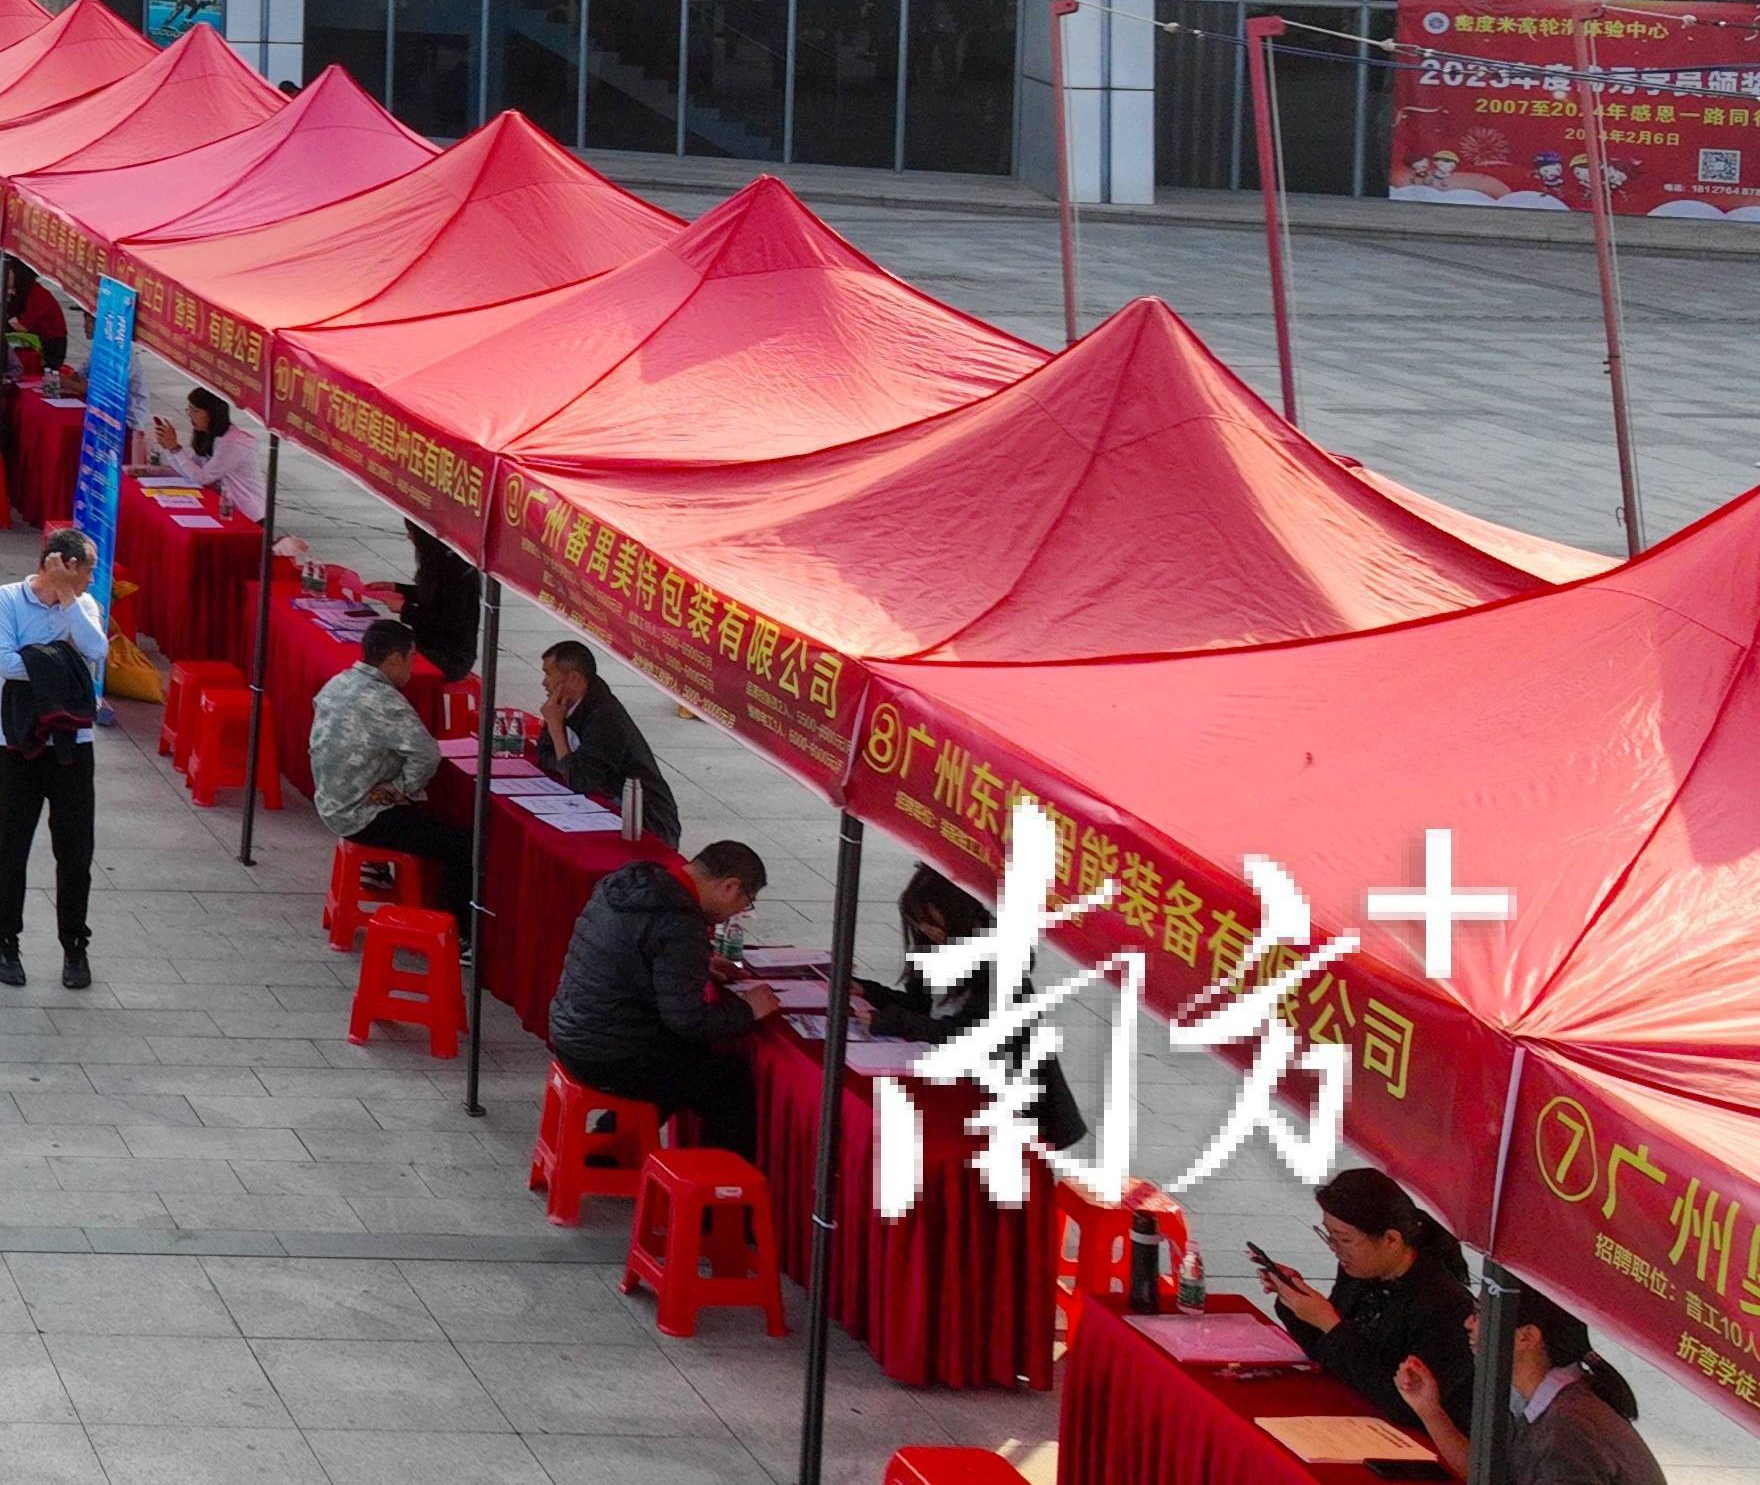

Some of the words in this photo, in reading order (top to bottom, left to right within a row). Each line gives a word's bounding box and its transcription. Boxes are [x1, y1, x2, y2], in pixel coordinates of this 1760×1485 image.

[1564, 127, 1681, 147] 204年2月6日
[522, 487, 844, 719] 广州番禺美特包装有限公司
[899, 722, 1415, 1099] 广州东智能装备有限公司
[1594, 1231, 1677, 1302] 招聘职位：
